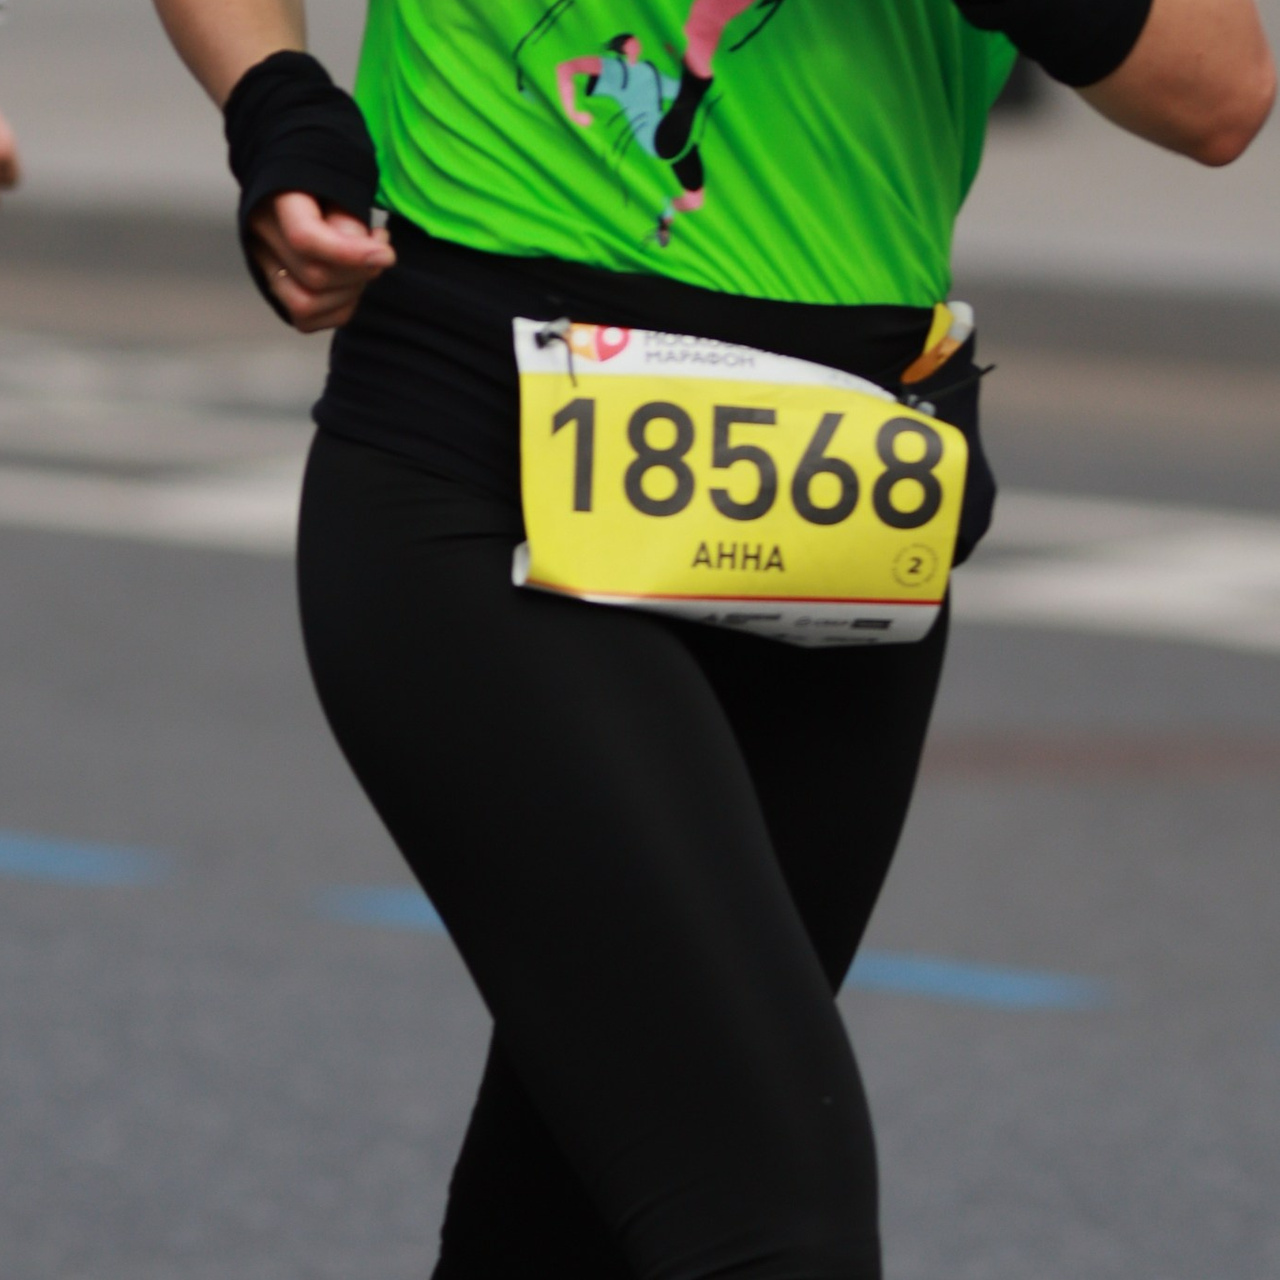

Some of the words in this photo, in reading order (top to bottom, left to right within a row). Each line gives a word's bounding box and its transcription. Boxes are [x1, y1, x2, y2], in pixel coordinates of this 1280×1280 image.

[551, 397, 944, 531] 18568
[691, 541, 786, 574] АННА
[908, 556, 923, 574] 2
